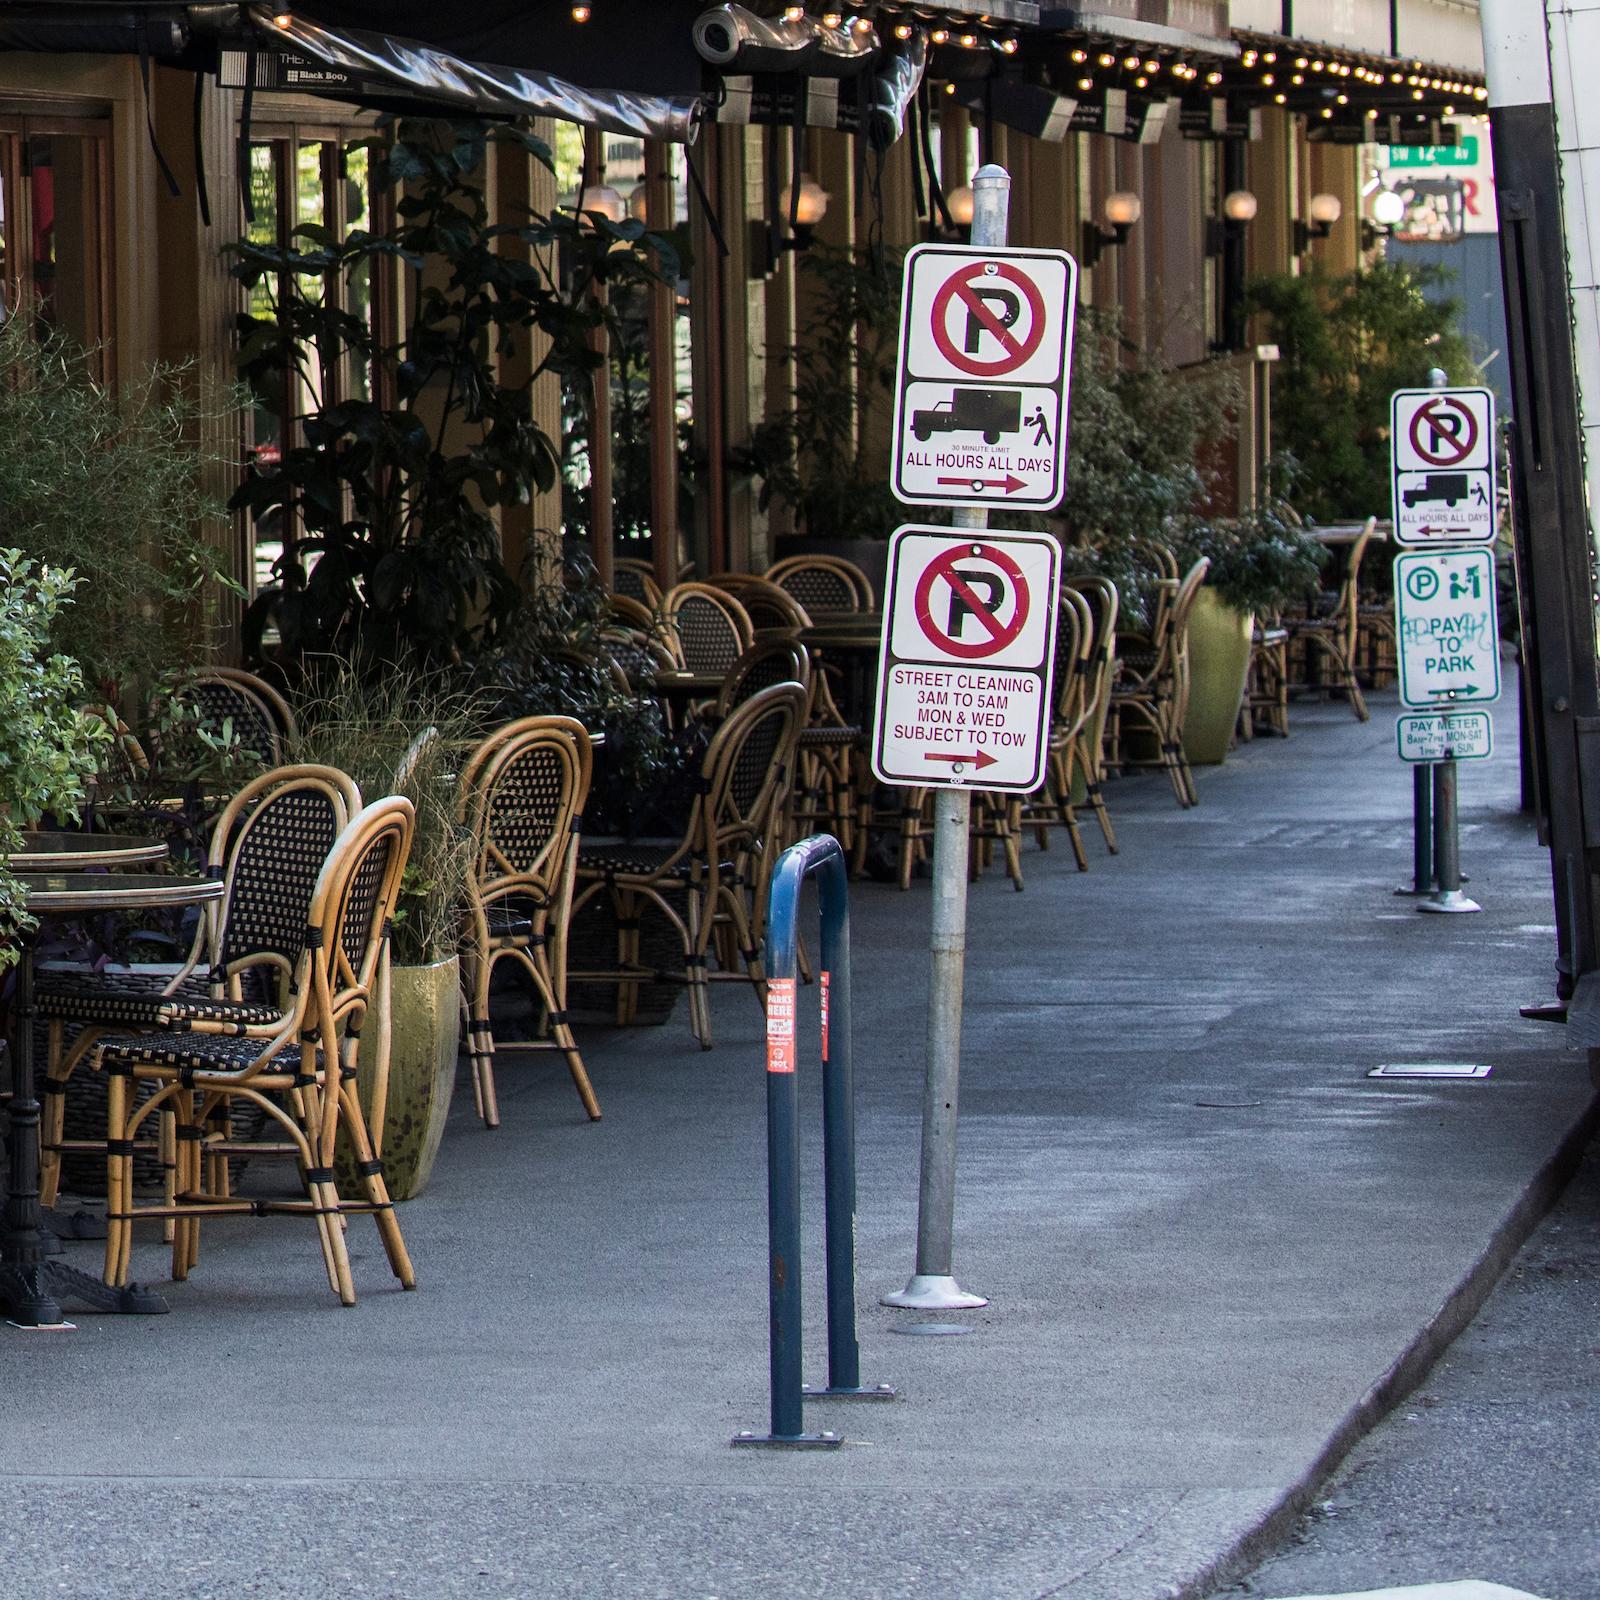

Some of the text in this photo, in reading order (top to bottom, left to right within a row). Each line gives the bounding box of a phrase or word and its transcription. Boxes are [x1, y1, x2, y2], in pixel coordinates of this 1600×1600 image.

[299, 70, 323, 80] Black
[961, 445, 989, 453] MINUTE
[990, 446, 1010, 454] LIMIT
[906, 452, 1052, 473] ALL HOURS ALL DAYS
[1402, 511, 1489, 523] ALL HOURS ALL DAYS
[1430, 615, 1465, 635] PAY
[1436, 636, 1461, 654] TO
[1425, 655, 1476, 674] PARK
[895, 670, 1035, 693] STREET CLEANING
[917, 690, 1009, 710] 3AM TO 5AM
[917, 708, 1006, 728] MON & WED
[1410, 717, 1479, 733] PAY METER
[894, 725, 1026, 747] SUBJECT TO TOW
[1446, 729, 1482, 742] MON-SAT
[1457, 742, 1475, 754] SUN
